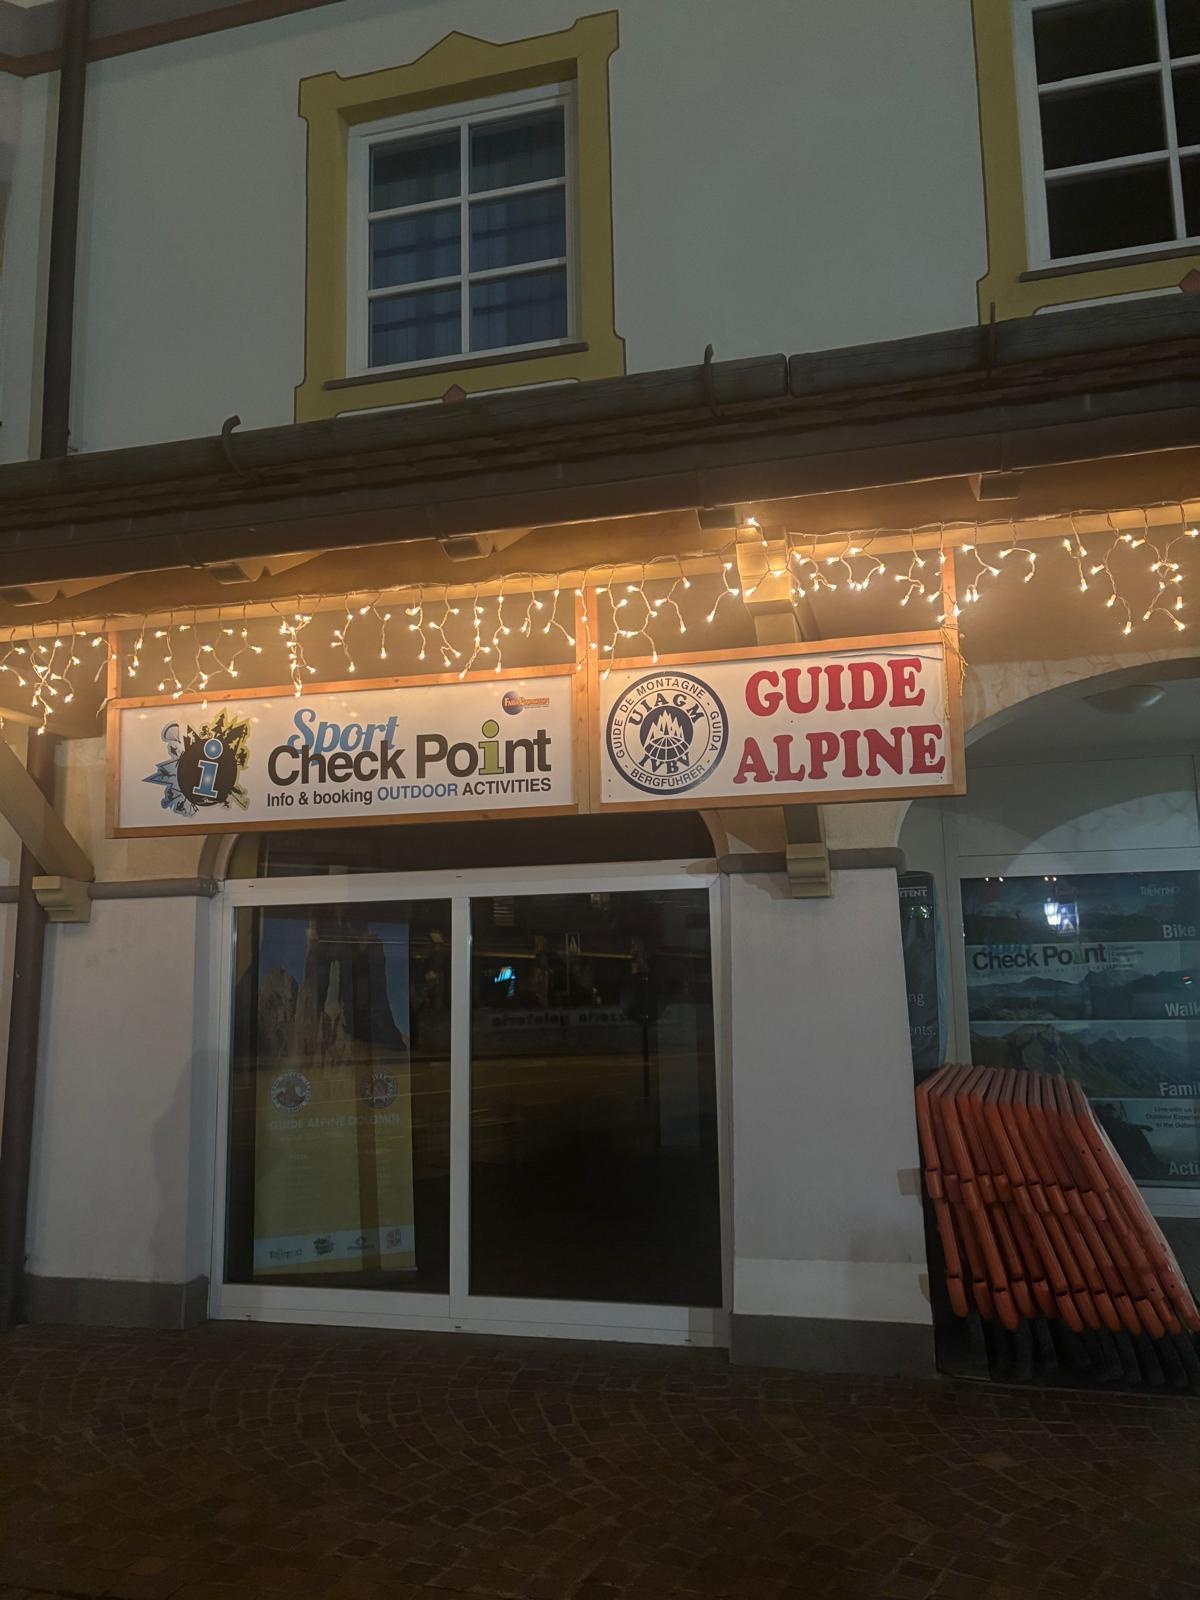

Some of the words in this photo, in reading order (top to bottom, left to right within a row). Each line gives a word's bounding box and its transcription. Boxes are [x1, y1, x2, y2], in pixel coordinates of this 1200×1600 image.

[745, 658, 926, 717] GUIDE
[612, 719, 625, 759] GUIDE
[619, 697, 635, 713] DE
[636, 677, 706, 699] MONTAGNE
[628, 692, 705, 726] UIAGM
[267, 739, 406, 784] Check
[416, 719, 552, 779] Point
[287, 708, 400, 766] Sport
[708, 710, 723, 752] GUIDA
[638, 751, 691, 774] IVBV
[733, 724, 946, 784] ALPINE
[267, 791, 294, 807] Info
[298, 791, 309, 806] &
[313, 788, 373, 808] booking
[377, 783, 458, 801] OUTDOOR
[462, 777, 552, 796] ACTIVITIES
[1162, 924, 1196, 939] Bike
[972, 948, 1038, 970] Check
[1043, 941, 1107, 967] Point
